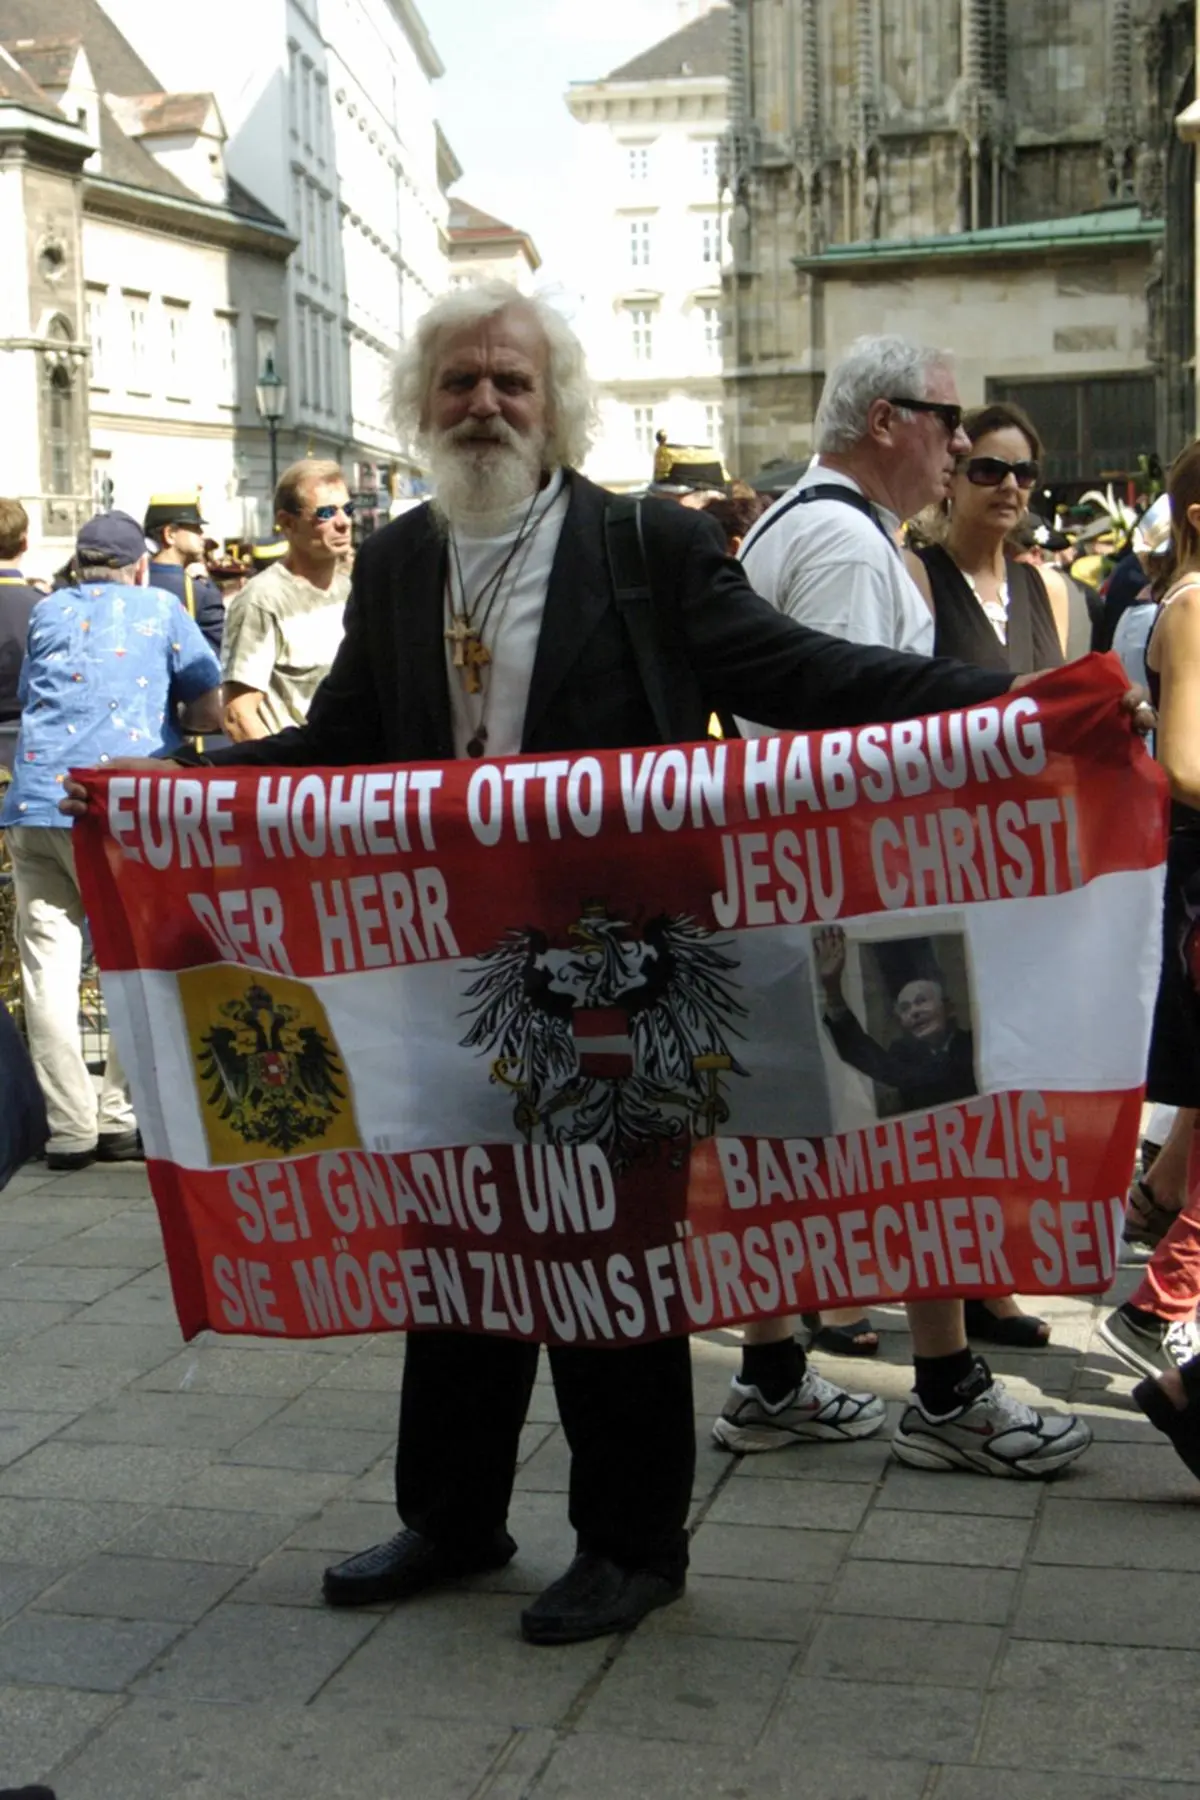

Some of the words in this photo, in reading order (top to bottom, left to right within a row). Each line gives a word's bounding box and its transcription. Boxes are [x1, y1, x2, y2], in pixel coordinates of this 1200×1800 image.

[108, 776, 242, 870] EURE
[256, 769, 443, 858] HOHEIT
[467, 757, 601, 847] OTTO
[619, 745, 726, 832] VON
[743, 696, 1046, 821] HABSBURG
[188, 886, 294, 976] DER
[311, 867, 460, 973] HERR
[711, 826, 844, 929] JESU
[870, 796, 1083, 909] CHRISTI
[228, 1163, 311, 1244] SEI
[516, 1144, 616, 1234] UND
[715, 1091, 1069, 1210] BARMHERZIG;
[213, 1255, 286, 1333] SIE
[292, 1236, 470, 1332] MÖGEN
[468, 1251, 533, 1335] ZU
[536, 1253, 646, 1343] UNS
[645, 1195, 1015, 1333] FÜRSPRECHER
